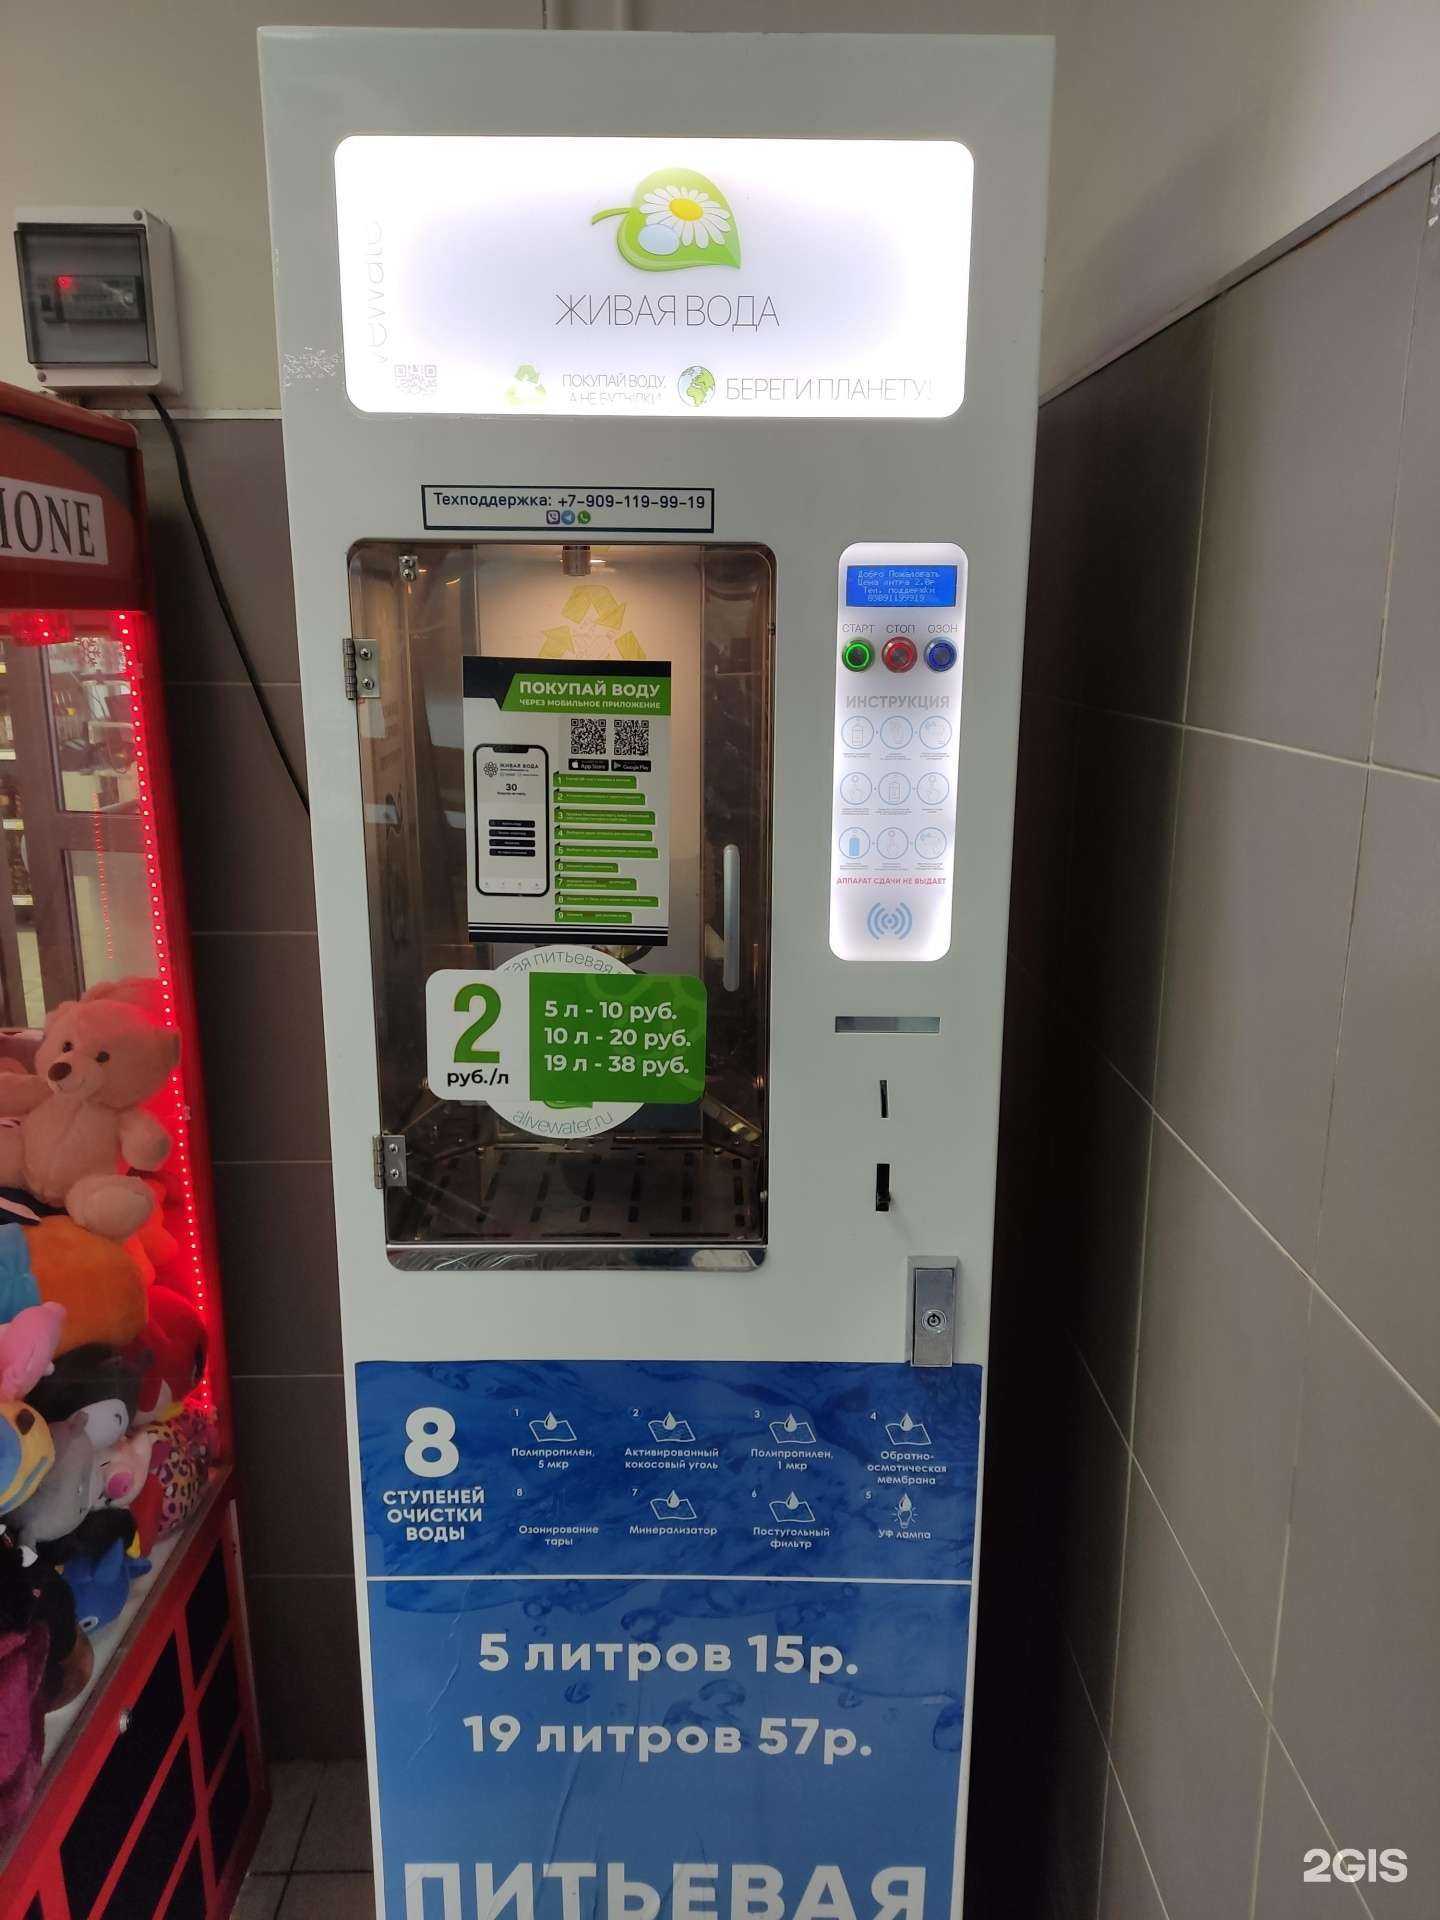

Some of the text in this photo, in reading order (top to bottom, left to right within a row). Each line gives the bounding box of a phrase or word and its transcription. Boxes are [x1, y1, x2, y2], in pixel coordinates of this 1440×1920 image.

[554, 294, 780, 332] ЖИВАЯ ВОДА
[562, 371, 627, 388] ПОКУПАЙ
[726, 378, 811, 401] БЕРЕГИ
[432, 492, 706, 510] Техподдержка: +7-909-119-99-19
[841, 624, 959, 633] СТАРТ СТОП ОЗОН
[519, 680, 660, 699] ПОКУПАЙ ВОДУ
[519, 698, 661, 709] ЧЕРЕЗ МОБИЛЬНОЕ ПРИЛОЖЕНИЕ
[845, 695, 951, 710] ИНСТРУКЦИЯ
[505, 783, 518, 792] 30
[836, 877, 947, 886] АППАРАТ СДАЧИ НЕ ВЫДАЕТ
[534, 951, 614, 974] питьевая
[544, 1000, 558, 1018] 5
[563, 1002, 578, 1018] л
[599, 1001, 623, 1019] 10
[629, 1001, 677, 1023] руб.
[453, 983, 502, 1064] 2
[544, 1027, 568, 1045] 10
[574, 1030, 589, 1046] л
[609, 1028, 638, 1047] 20
[644, 1029, 692, 1051] руб.
[544, 1054, 568, 1073] 19
[572, 1057, 588, 1073] л
[608, 1055, 636, 1073] 38
[642, 1056, 689, 1077] руб.
[447, 1068, 509, 1088] руб./л
[512, 1110, 614, 1136] alivewater.ru
[514, 1408, 520, 1417] 1
[632, 1408, 640, 1417] 2
[754, 1410, 761, 1419] 3
[869, 1412, 877, 1421] 4
[404, 1406, 460, 1478] 8
[511, 1447, 596, 1459] Полипропилен,
[624, 1447, 719, 1458] Активированный
[750, 1448, 834, 1460] Полипропилен,
[880, 1451, 935, 1462] Обратно-
[538, 1460, 569, 1471] 5 мкр
[624, 1459, 719, 1471] кокосовый уголь
[785, 1462, 808, 1472] мкр
[867, 1463, 947, 1474] осмотическая
[877, 1475, 936, 1485] мембрана
[383, 1485, 485, 1505] СТУПЕНЕЙ
[516, 1488, 523, 1497] 8
[632, 1488, 640, 1497] 7
[751, 1489, 757, 1498] 6
[865, 1490, 872, 1500] 5
[386, 1507, 482, 1524] ОЧИСТКИ
[406, 1526, 465, 1544] ВОДЫ
[518, 1525, 600, 1536] Озонирование
[629, 1526, 718, 1537] Минерализатор
[752, 1526, 830, 1538] Постугольный
[878, 1528, 932, 1540] УФ лампа
[544, 1537, 573, 1547] тары
[770, 1538, 812, 1550] фильтр
[478, 1633, 859, 1684] 5 литров 15р.
[462, 1714, 873, 1765] 19 литров 57р.
[403, 1861, 927, 1920] ПИТЬЕВАЯ
